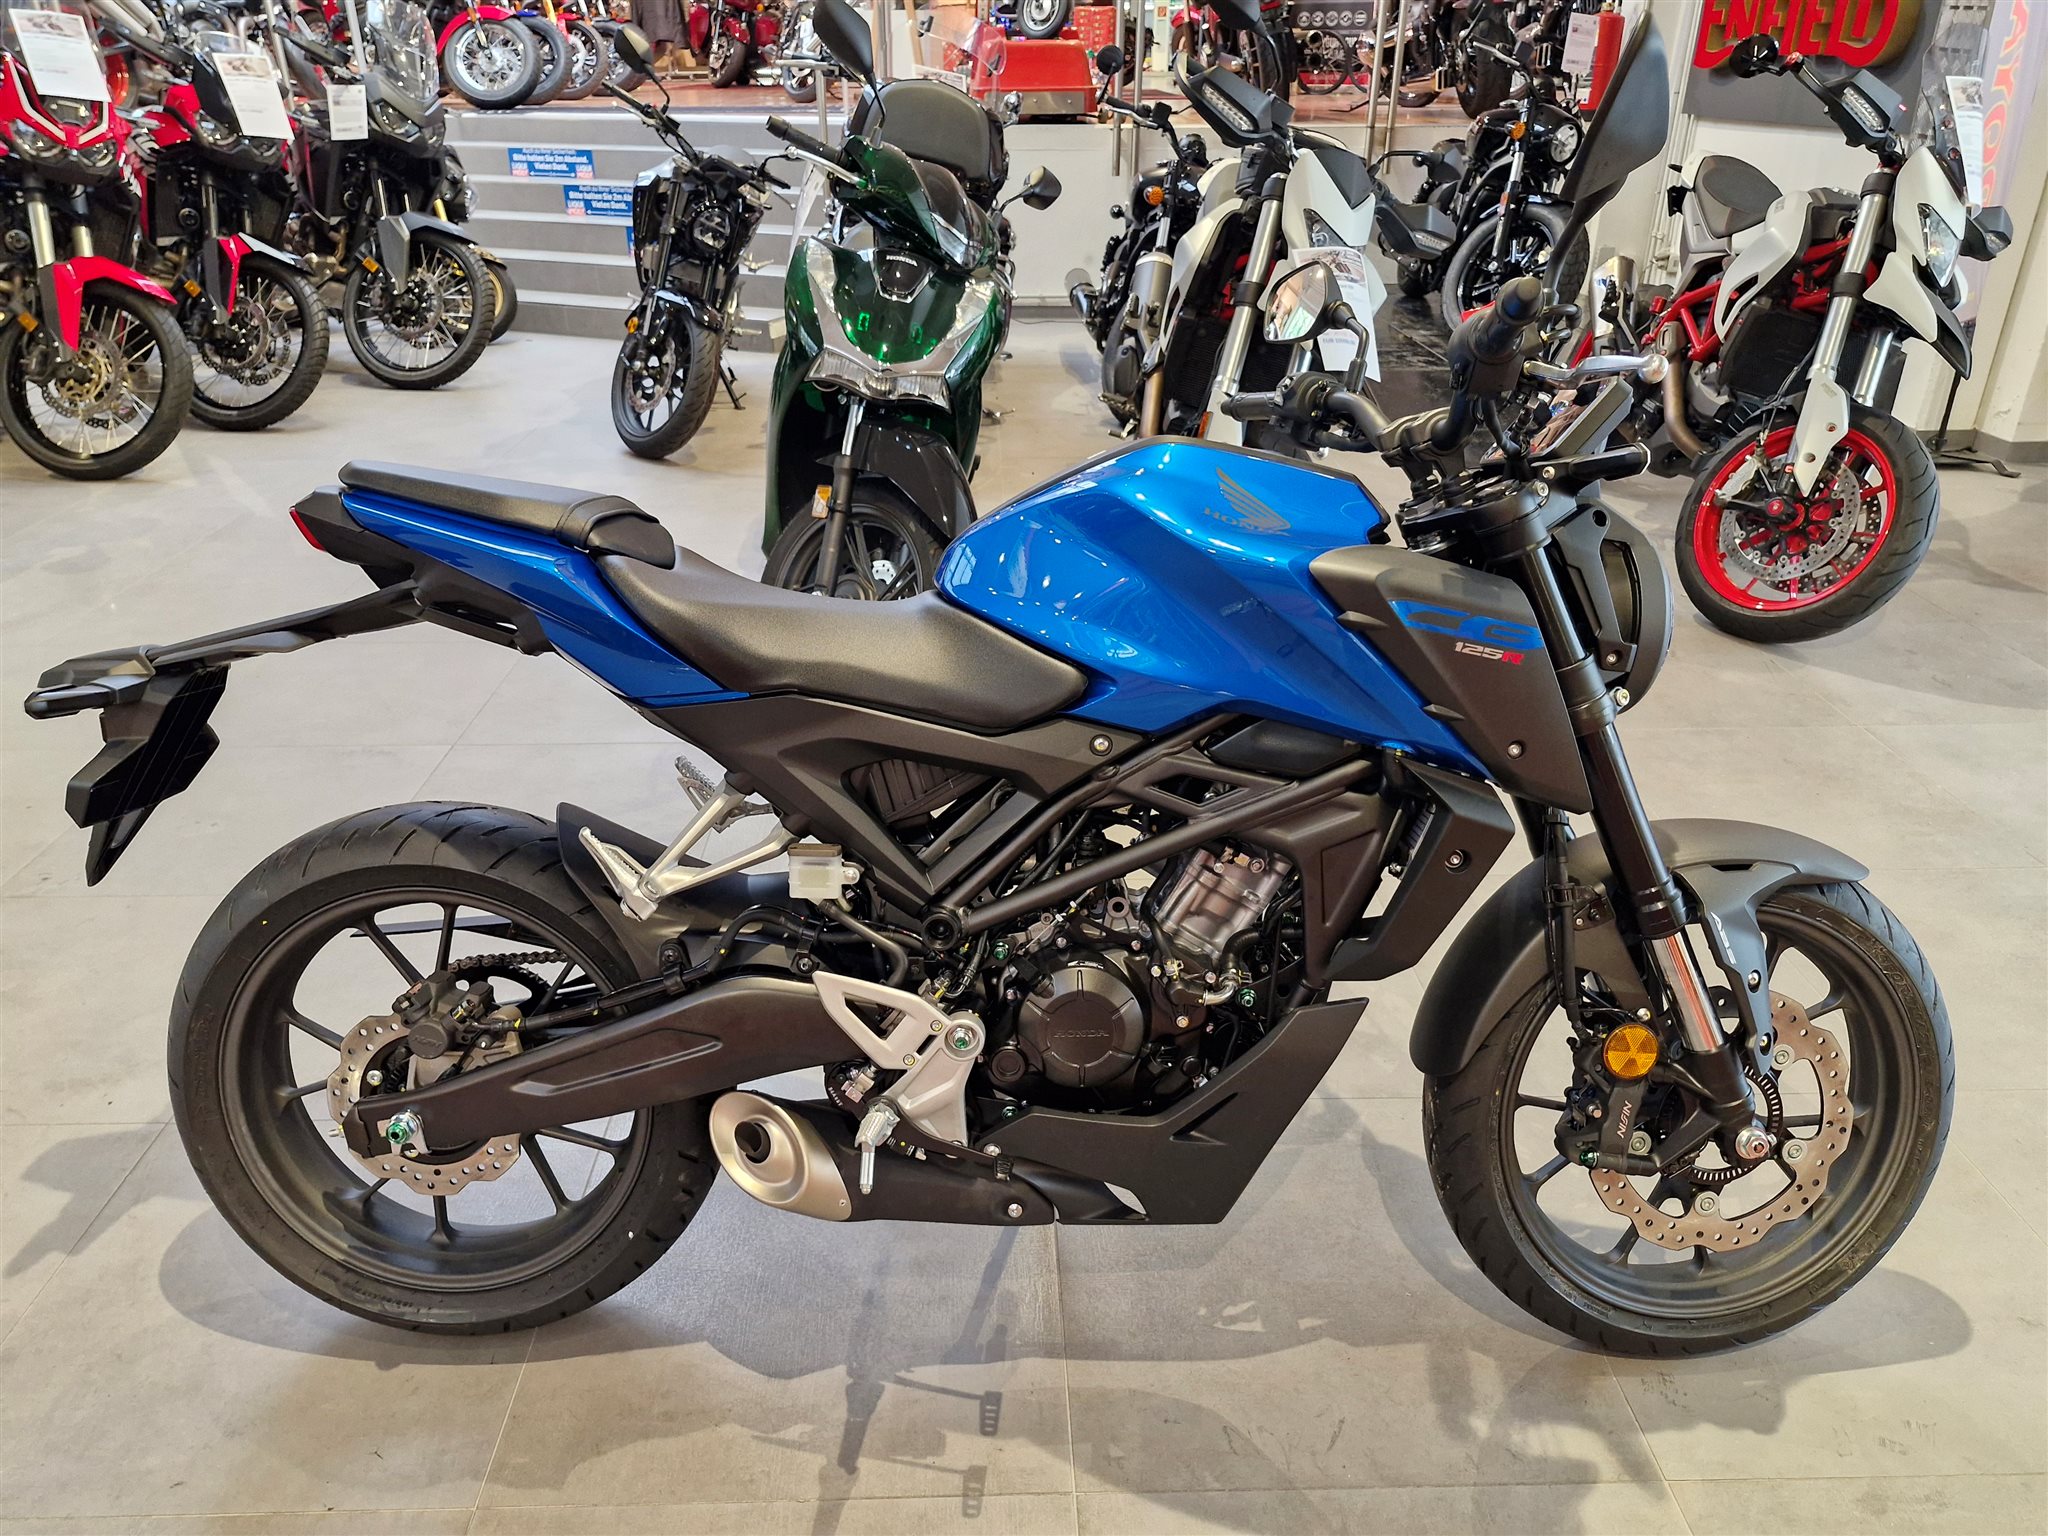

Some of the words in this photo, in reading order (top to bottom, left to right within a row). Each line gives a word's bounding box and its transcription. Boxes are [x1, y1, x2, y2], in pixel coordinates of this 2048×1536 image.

[886, 255, 918, 267] HONDA
[1387, 600, 1545, 650] CB
[1454, 641, 1525, 665] 125R
[1710, 911, 1737, 965] ABS
[1053, 1029, 1110, 1038] HONDA
[1616, 1100, 1633, 1139] NISSIN
